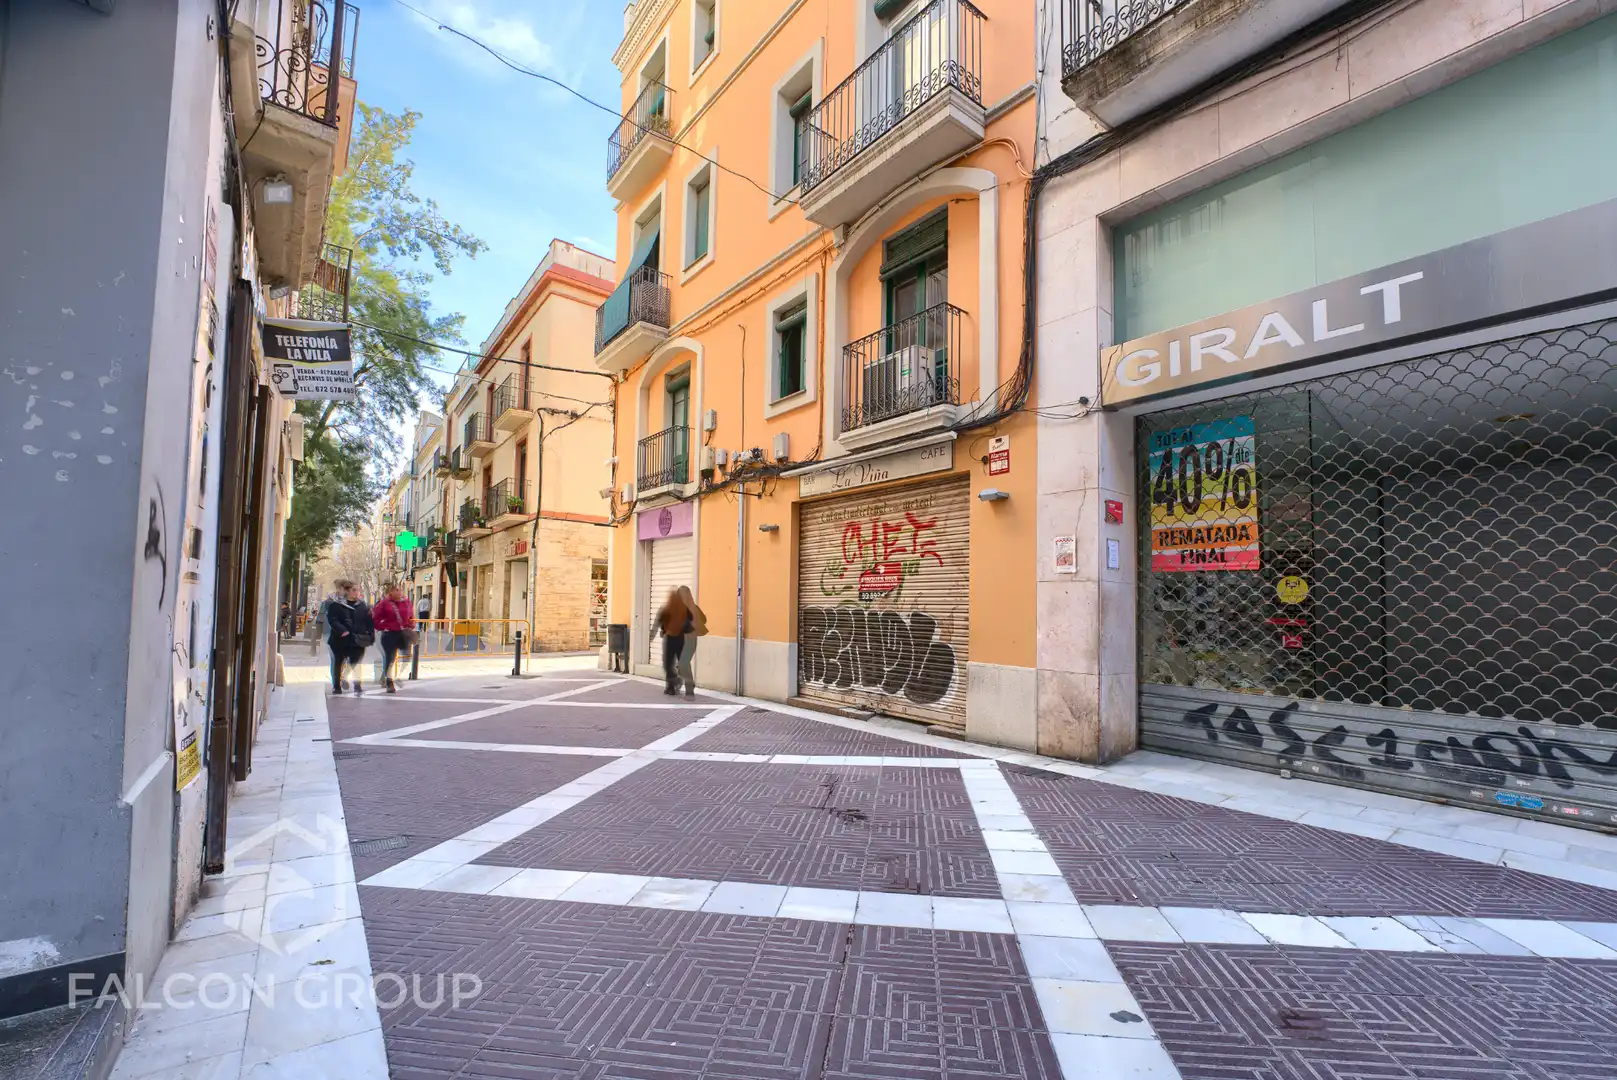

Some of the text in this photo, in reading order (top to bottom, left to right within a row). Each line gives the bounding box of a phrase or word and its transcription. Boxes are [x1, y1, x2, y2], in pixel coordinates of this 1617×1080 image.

[1115, 271, 1424, 387] GIRALT
[275, 334, 338, 349] TELEFONÍA
[286, 347, 332, 361] LA VILA
[920, 445, 946, 460] CAFE
[828, 463, 852, 489] La
[854, 463, 889, 484] Viña
[1153, 437, 1251, 516] 40%
[1158, 524, 1251, 547] REMATADA
[1180, 547, 1228, 565] FINAL
